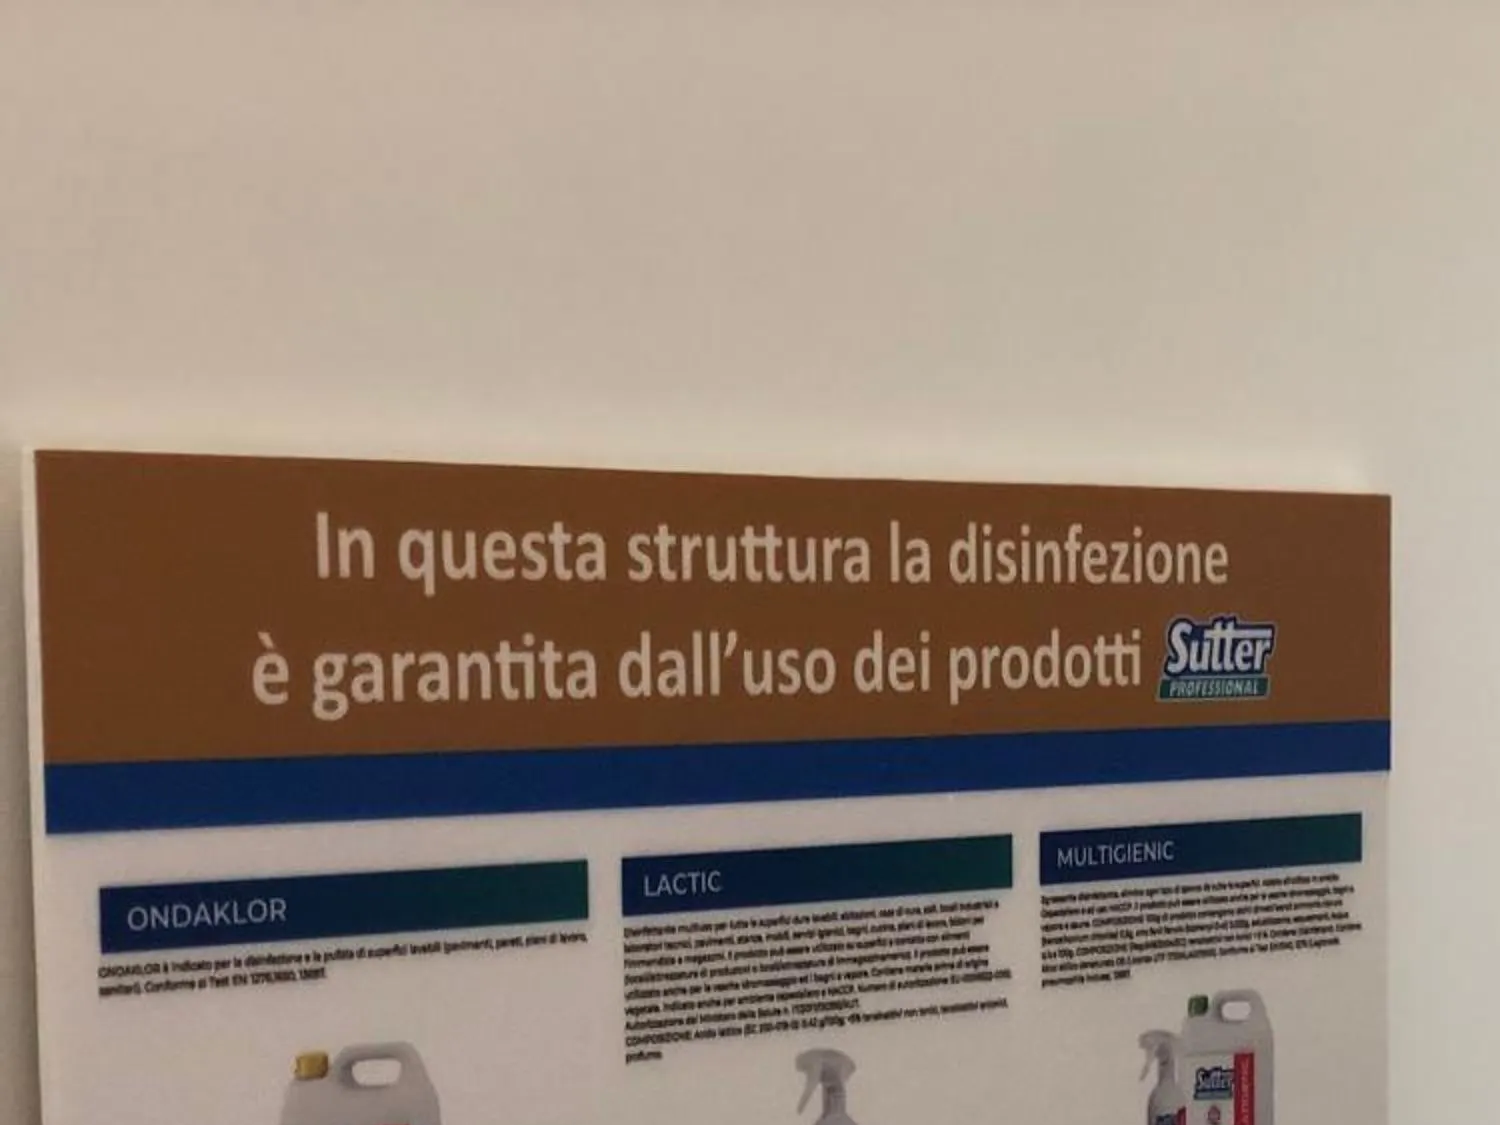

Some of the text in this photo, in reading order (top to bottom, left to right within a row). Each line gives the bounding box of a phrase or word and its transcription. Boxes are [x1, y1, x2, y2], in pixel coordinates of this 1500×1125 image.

[315, 512, 1229, 596] In questa struttura la disinfezione
[1166, 618, 1272, 674] Sutter
[252, 628, 1142, 721] è garantita dall’uso dei prodotti
[1168, 680, 1258, 698] PROFESSIONAL
[1056, 840, 1176, 870] MULTIGIENIC
[642, 870, 722, 898] LACTIC
[126, 898, 286, 932] ONDAKLOR
